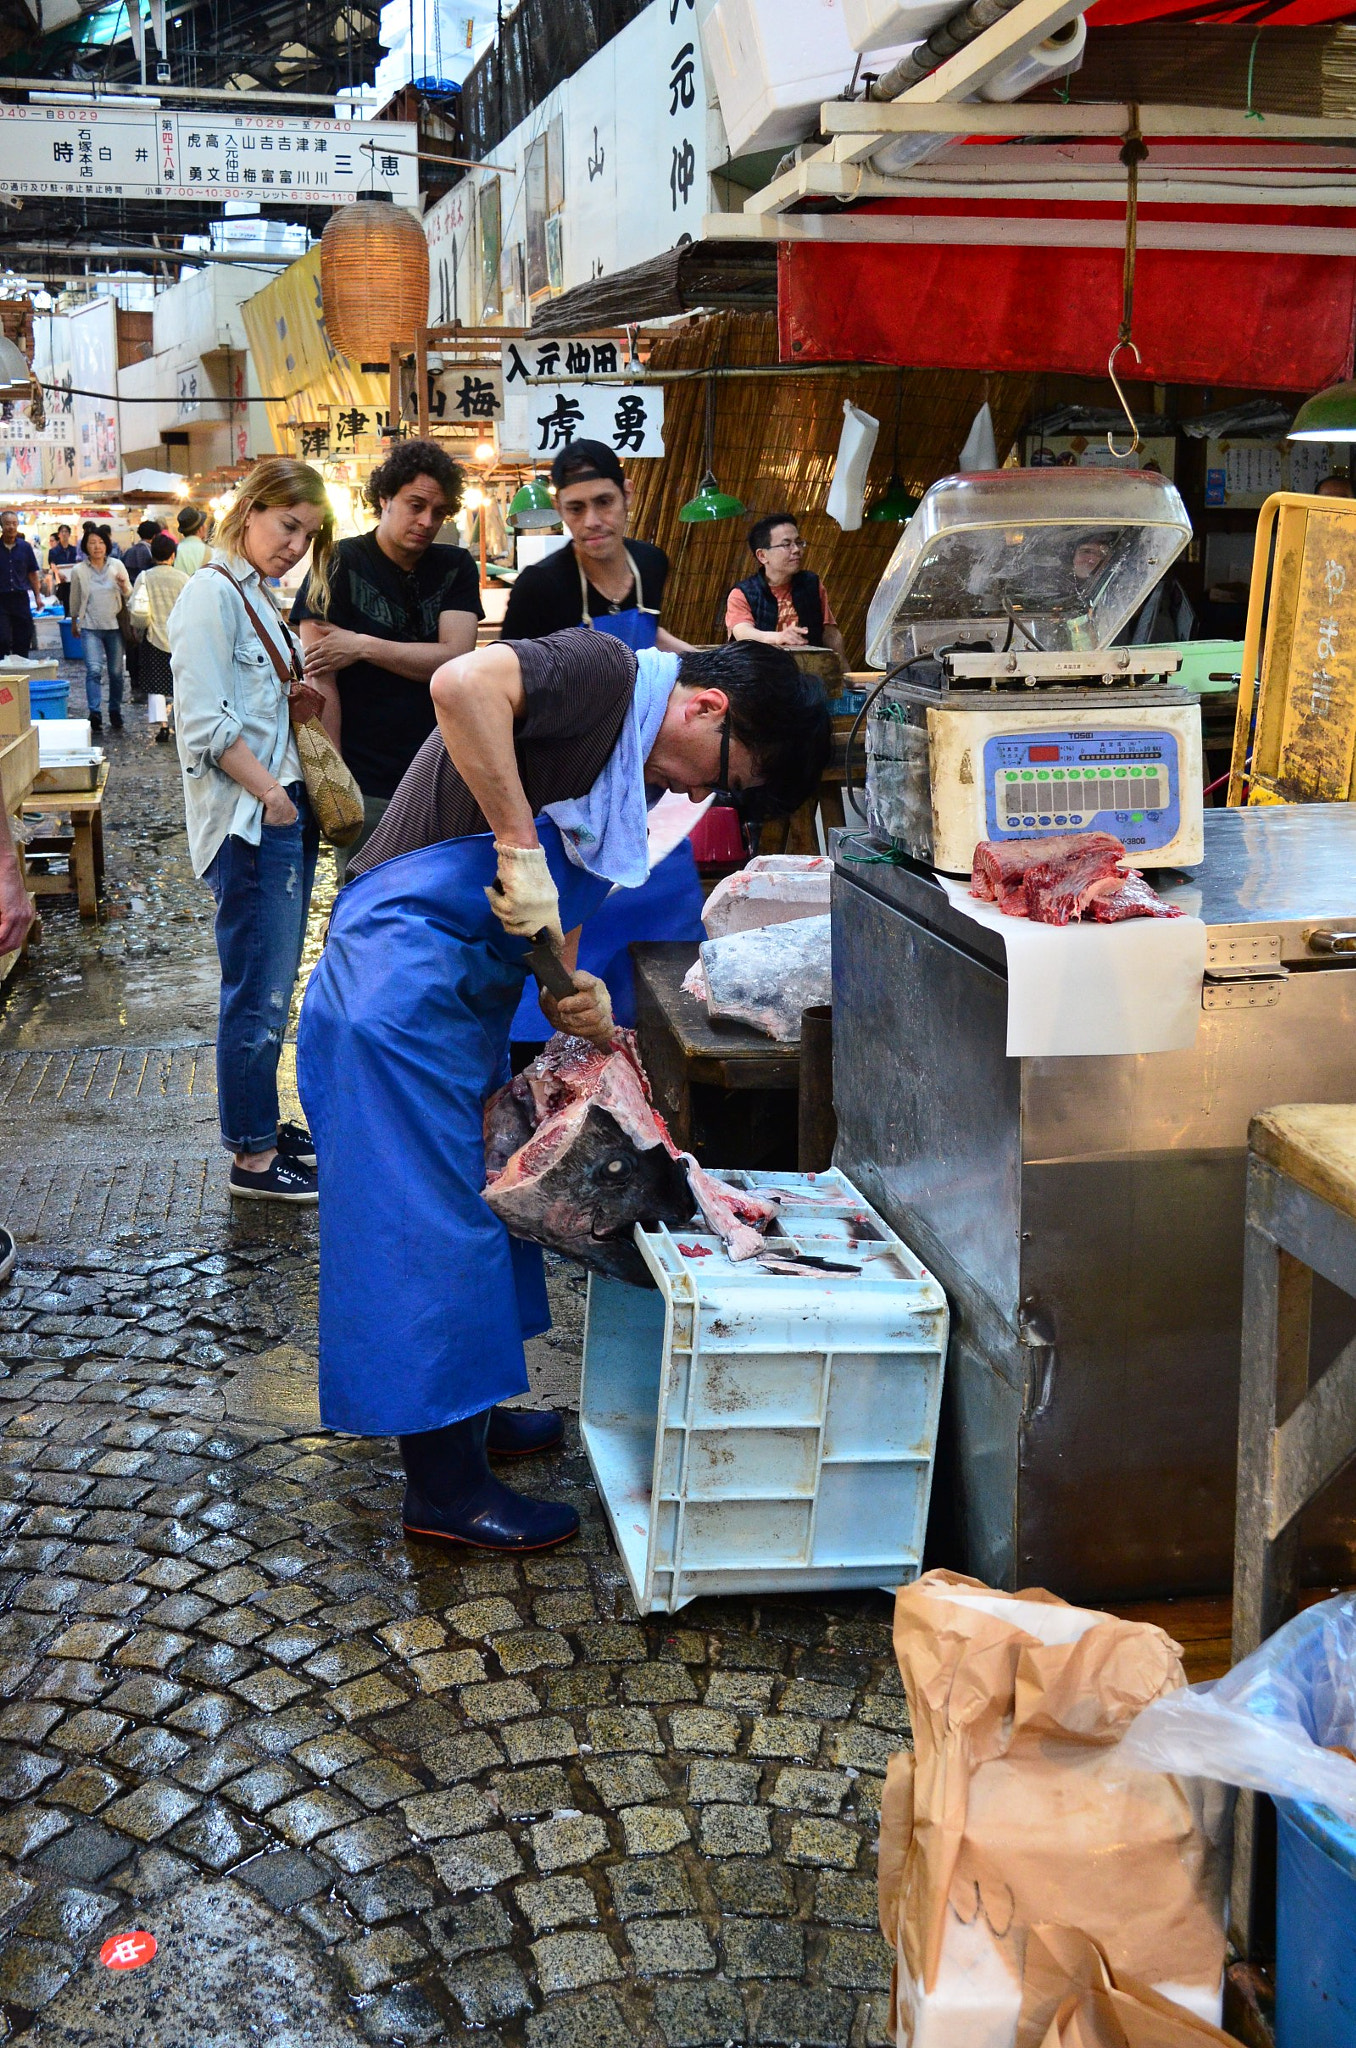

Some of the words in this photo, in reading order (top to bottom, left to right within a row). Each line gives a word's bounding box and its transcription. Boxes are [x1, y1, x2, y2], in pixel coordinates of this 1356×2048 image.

[53, 141, 74, 163] 時
[77, 128, 93, 178] 石塚本店
[161, 119, 175, 181] 第四十八棟
[669, 0, 695, 250] 元仲
[537, 393, 648, 452] 虎勇
